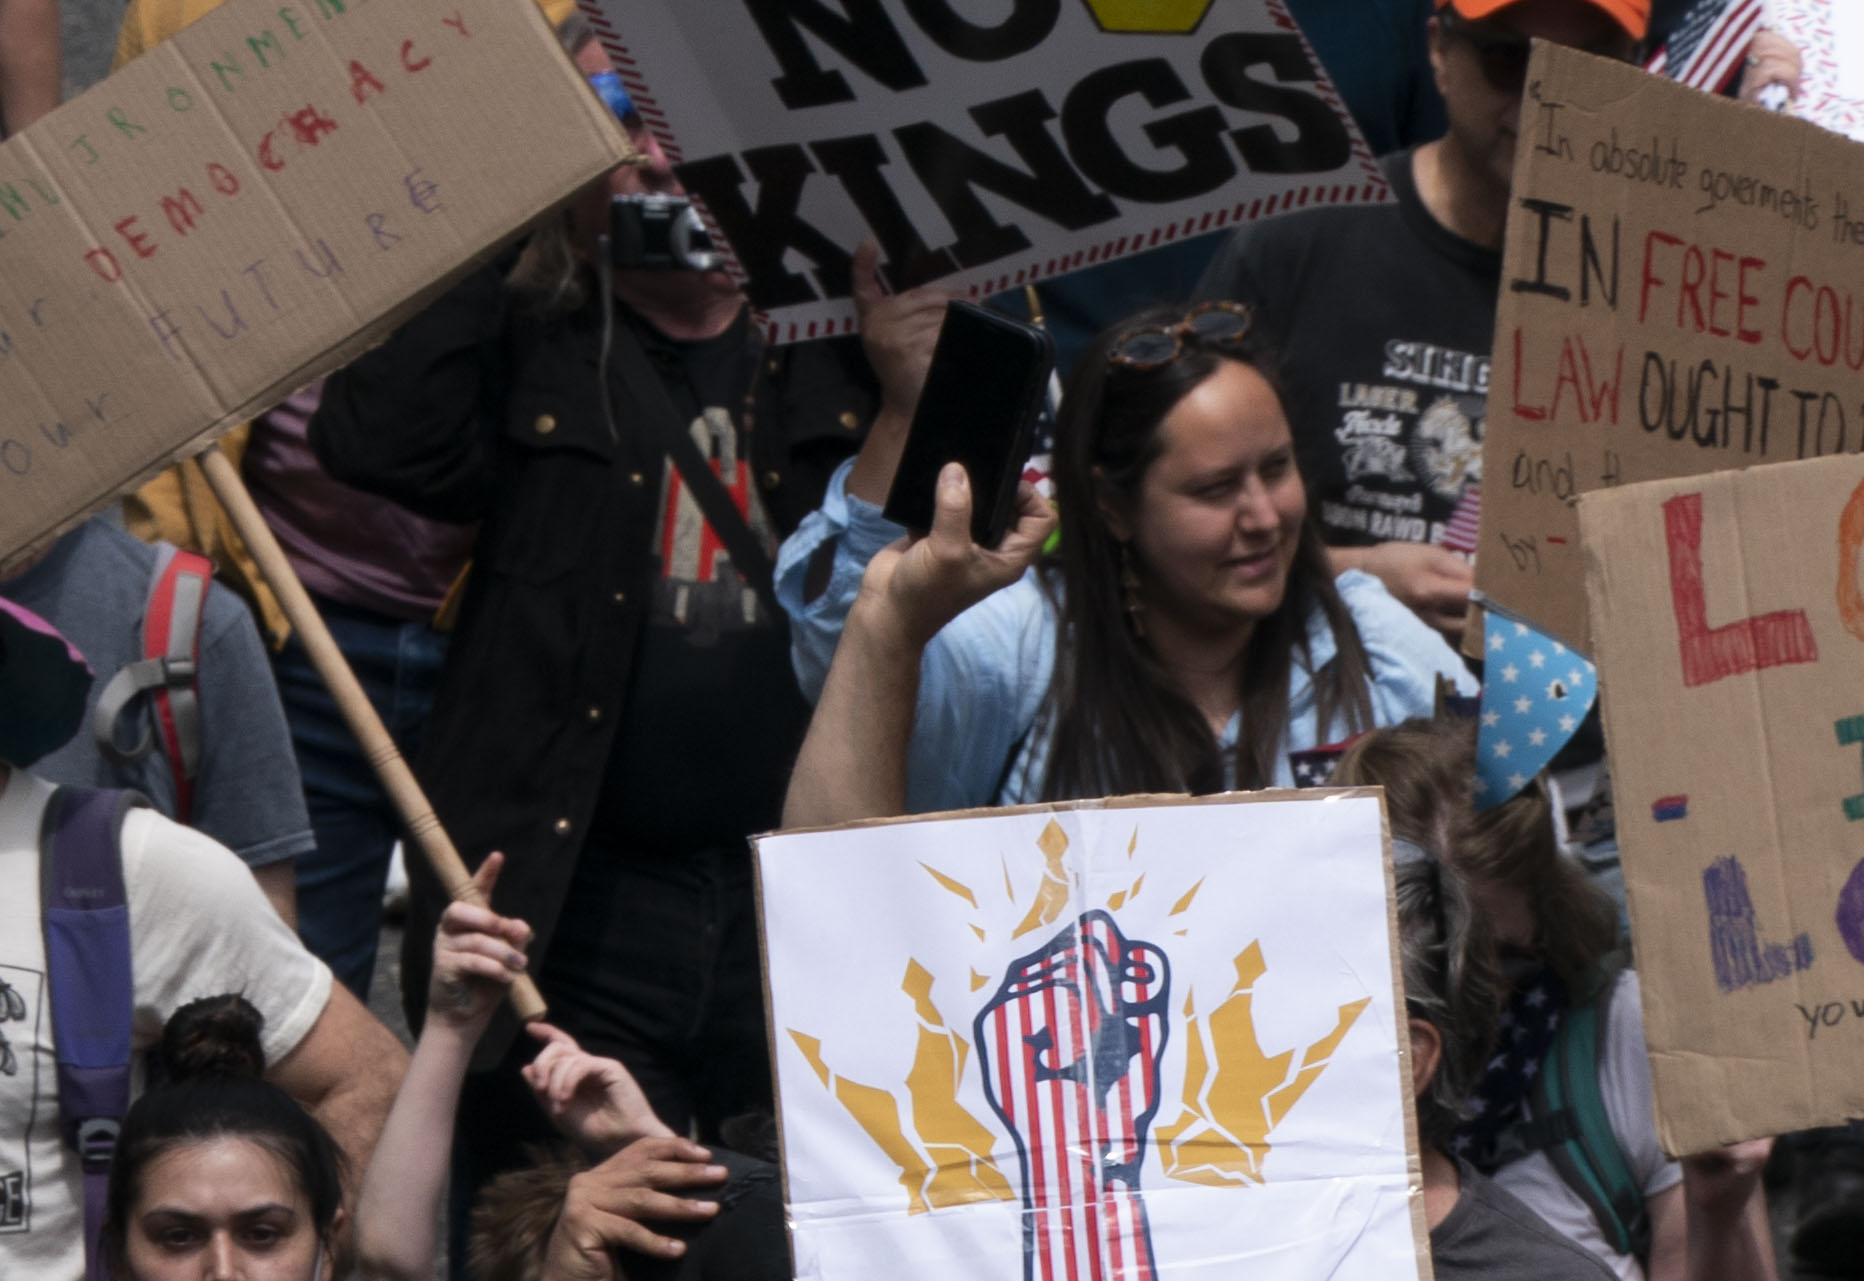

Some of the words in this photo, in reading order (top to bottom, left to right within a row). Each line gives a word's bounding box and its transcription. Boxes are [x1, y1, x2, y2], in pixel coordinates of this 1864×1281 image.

[744, 0, 1062, 110] NO
[670, 32, 1356, 310] KINGS
[1590, 135, 1689, 190] absolute
[150, 168, 442, 361] FUTURE
[1510, 197, 1620, 312] IN
[1638, 230, 1767, 344] FREE
[1510, 327, 1625, 426] LAW
[1638, 350, 1780, 457] OUGHT
[1789, 389, 1846, 460] TO
[1512, 448, 1576, 497] and
